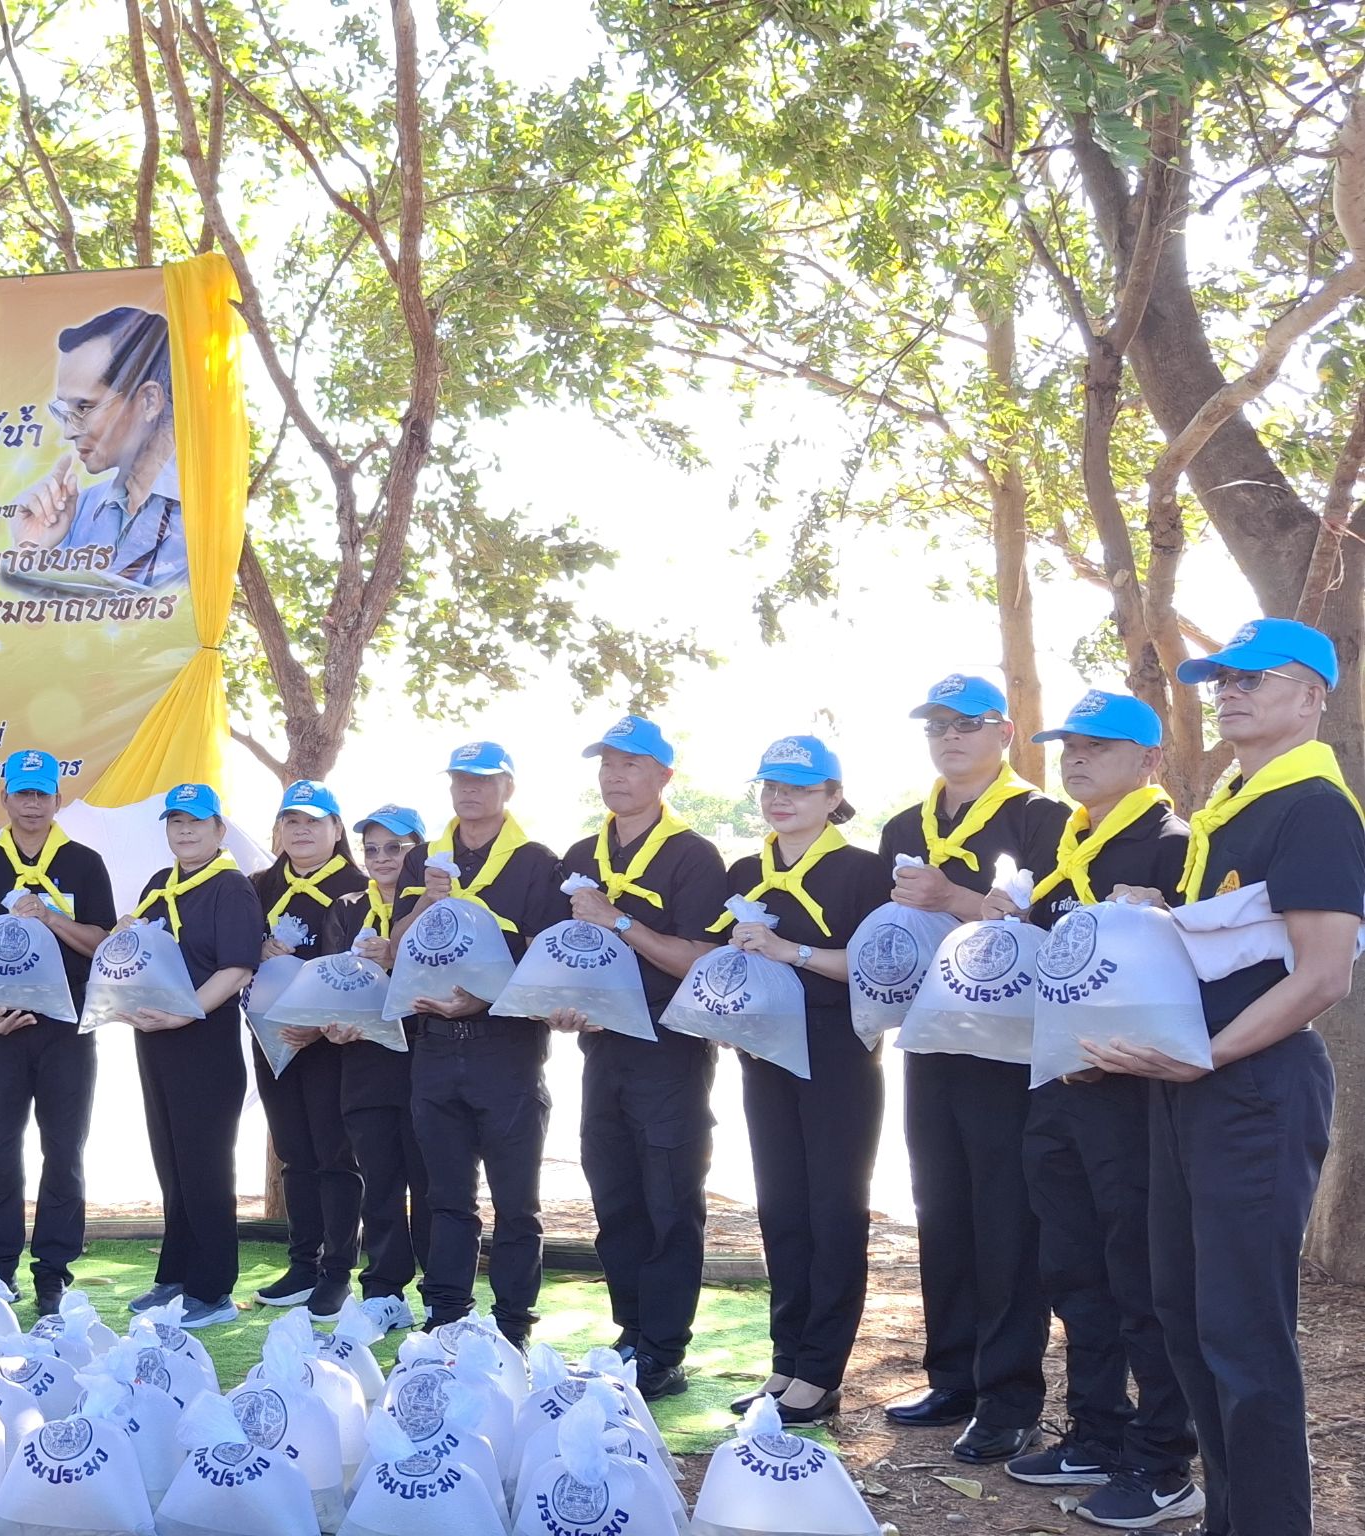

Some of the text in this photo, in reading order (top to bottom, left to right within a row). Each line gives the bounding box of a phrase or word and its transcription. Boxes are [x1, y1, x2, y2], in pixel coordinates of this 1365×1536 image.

[95, 950, 152, 980] กรมประมง
[406, 934, 474, 967] กรมประมง
[545, 935, 618, 970] กรมประมง
[939, 956, 1033, 1003] กรมประมง
[24, 1441, 109, 1484] กรมประมง
[194, 1446, 272, 1487] กรมประมง
[376, 1462, 462, 1500] กรมประมง
[734, 1444, 827, 1481] กรมประมง
